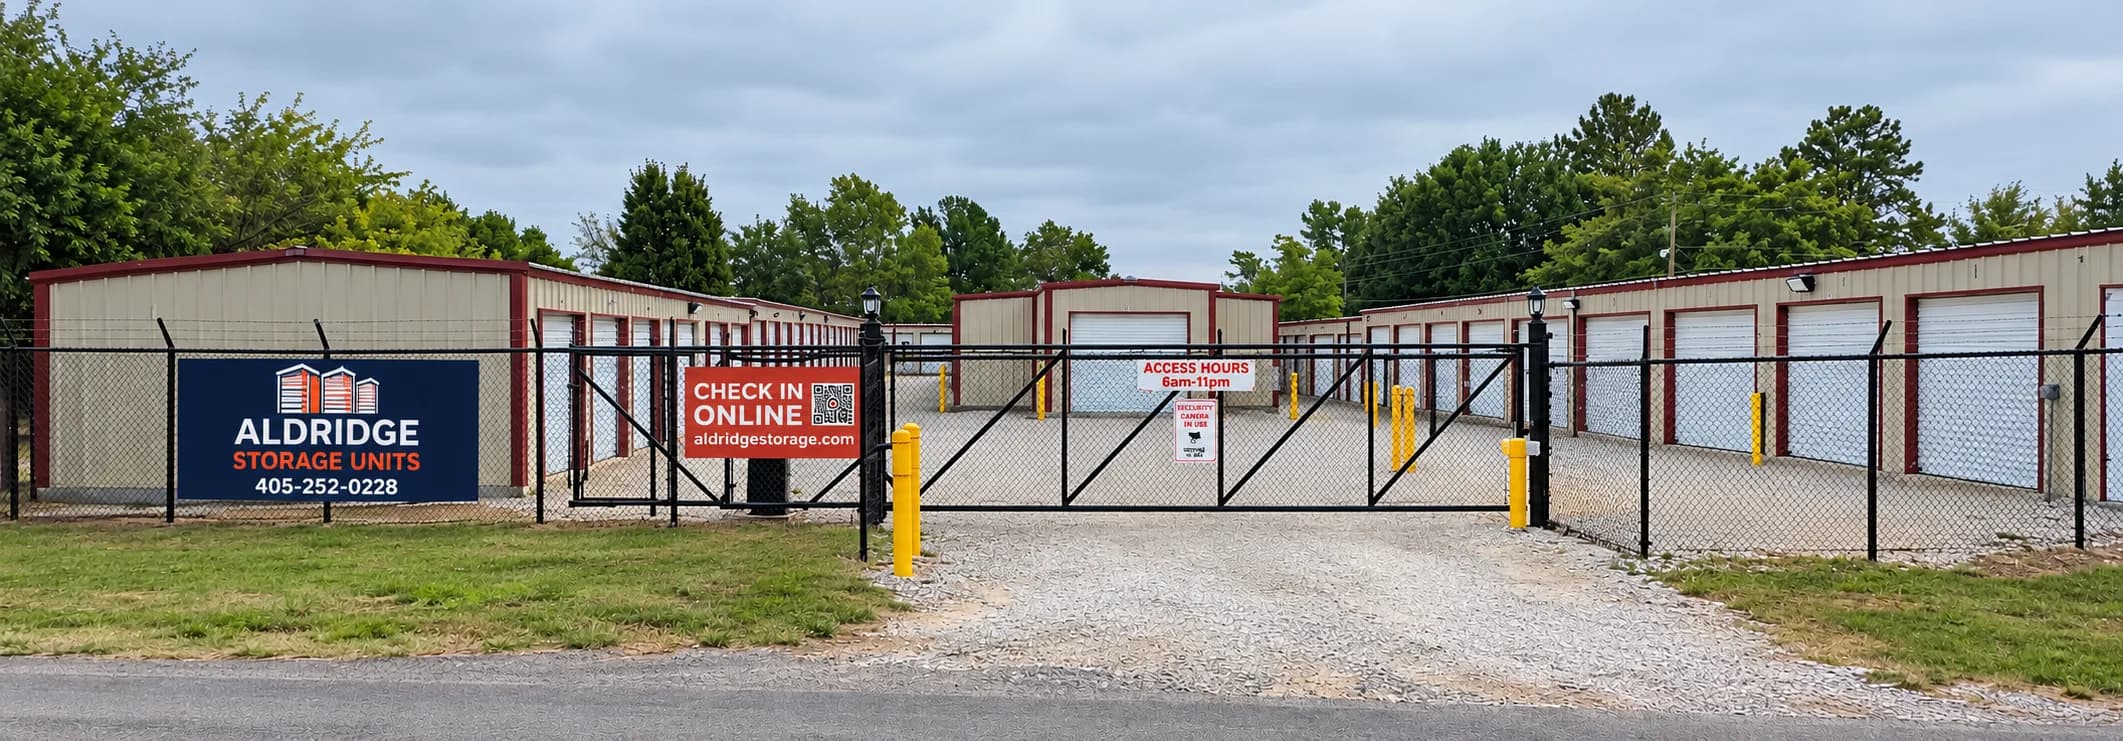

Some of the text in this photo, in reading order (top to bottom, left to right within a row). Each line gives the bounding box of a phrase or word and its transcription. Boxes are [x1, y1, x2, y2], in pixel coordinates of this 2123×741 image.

[1144, 362, 1249, 374] ACCESS HOURS
[1162, 376, 1230, 388] 6am-11pm
[694, 383, 803, 399] CHECK IN
[694, 405, 803, 426] ONLINE
[234, 418, 419, 446] ALDRIDGE
[694, 432, 854, 448] aldridgestorage.com
[233, 451, 420, 471] STORAGE UNITS
[255, 478, 398, 495] 405-252-0228
